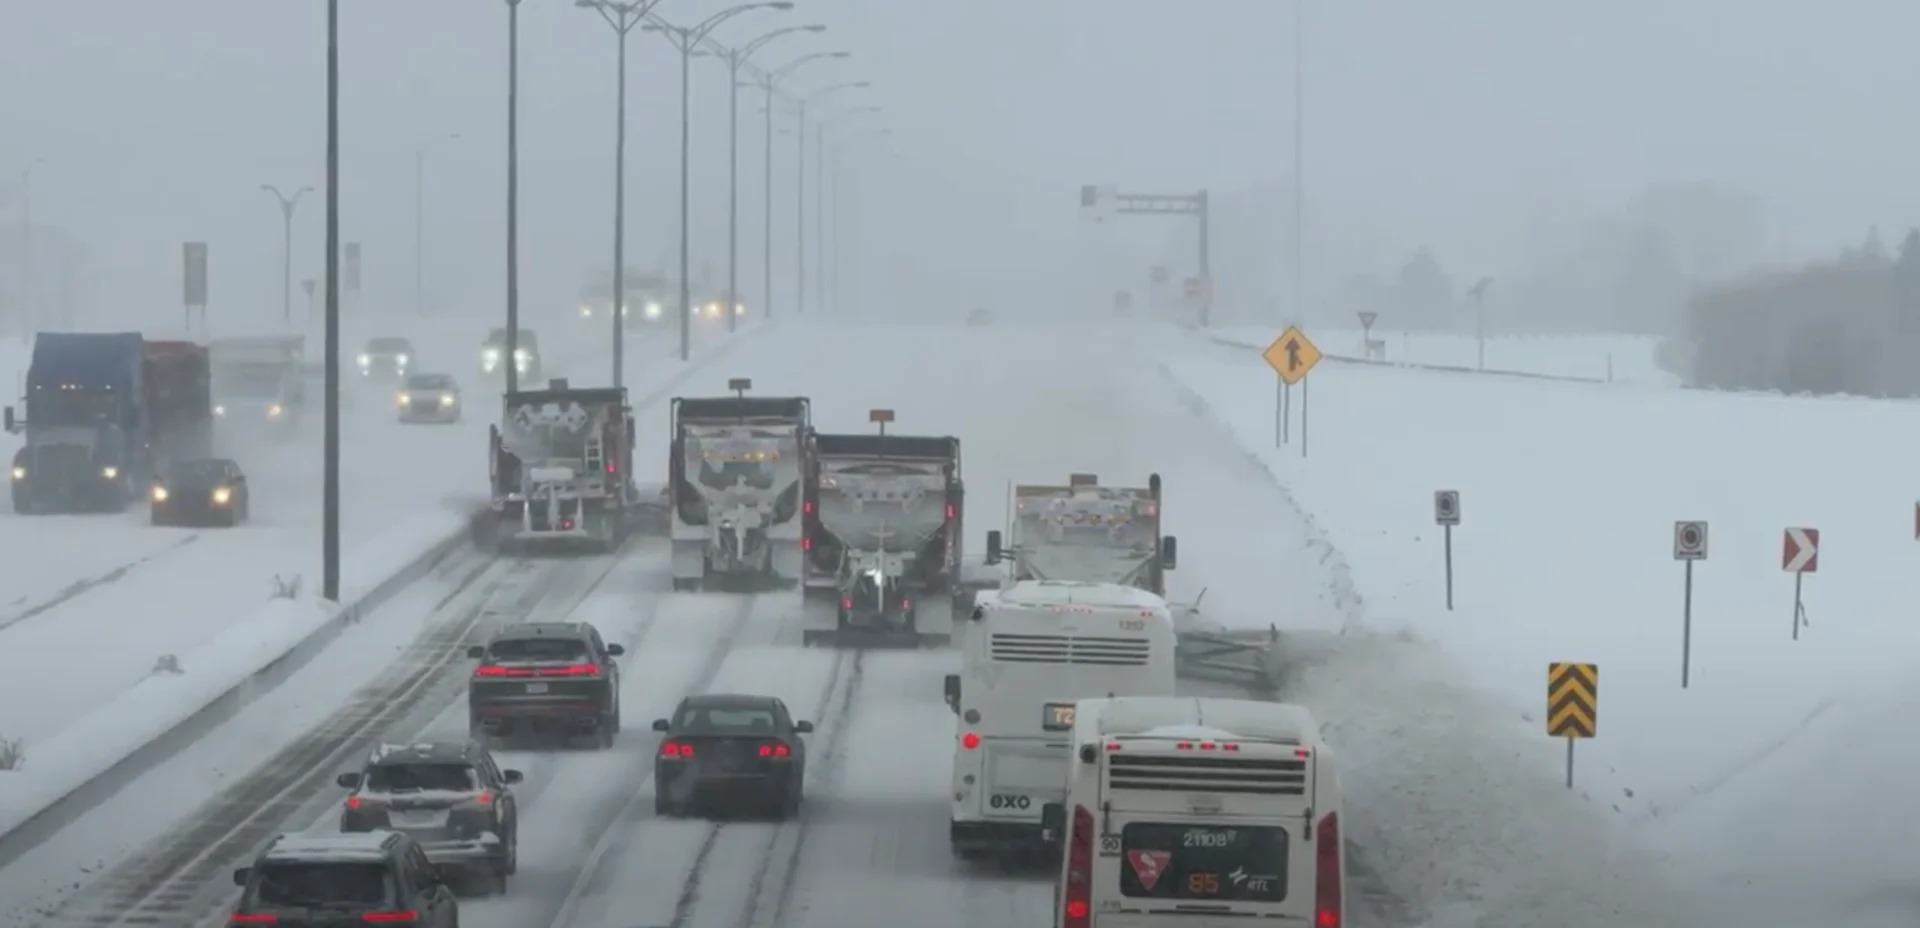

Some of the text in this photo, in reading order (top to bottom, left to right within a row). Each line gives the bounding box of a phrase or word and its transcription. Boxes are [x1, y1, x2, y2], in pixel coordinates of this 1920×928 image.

[990, 795, 1030, 809] exo
[1184, 833, 1227, 847] 21108
[1188, 873, 1219, 894] 85
[1247, 879, 1269, 892] RTL
